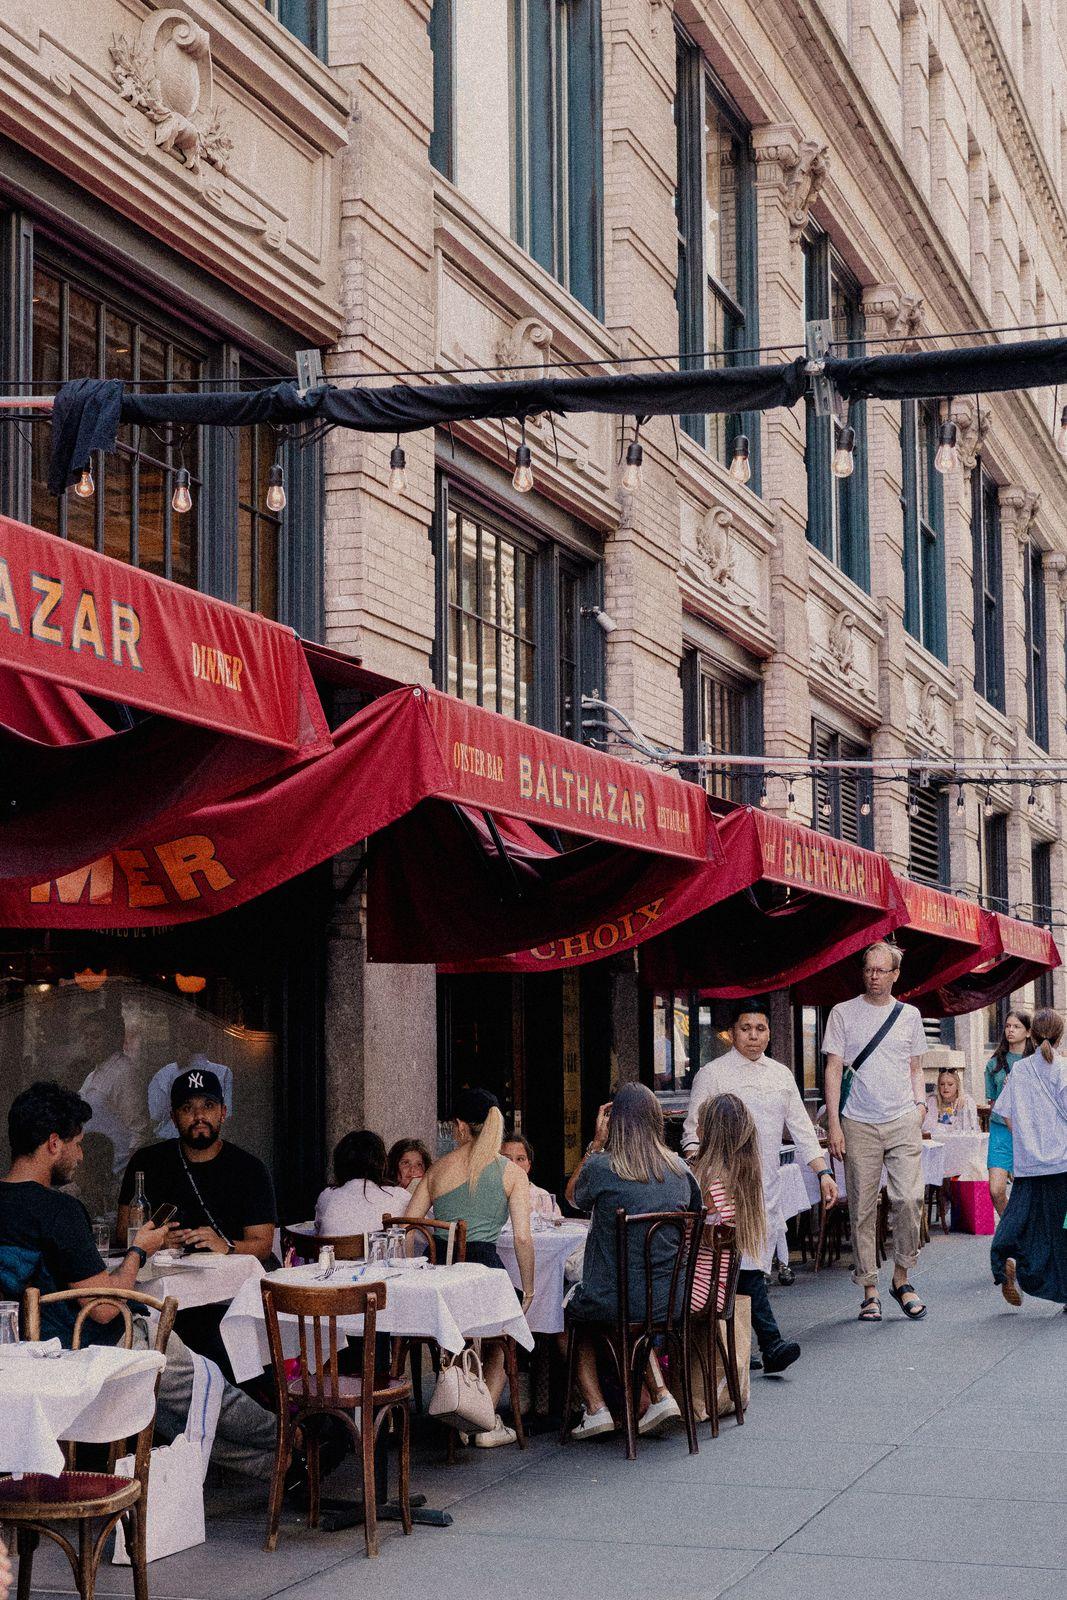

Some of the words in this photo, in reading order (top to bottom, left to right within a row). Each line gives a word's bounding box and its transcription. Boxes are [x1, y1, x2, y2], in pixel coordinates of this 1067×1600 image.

[191, 642, 243, 692] DINNER
[454, 741, 486, 777] OYSTER
[487, 752, 504, 782] BAR
[519, 753, 647, 832] BALTHAZAR
[530, 897, 665, 960] CHOIX
[188, 1072, 204, 1088] NY
